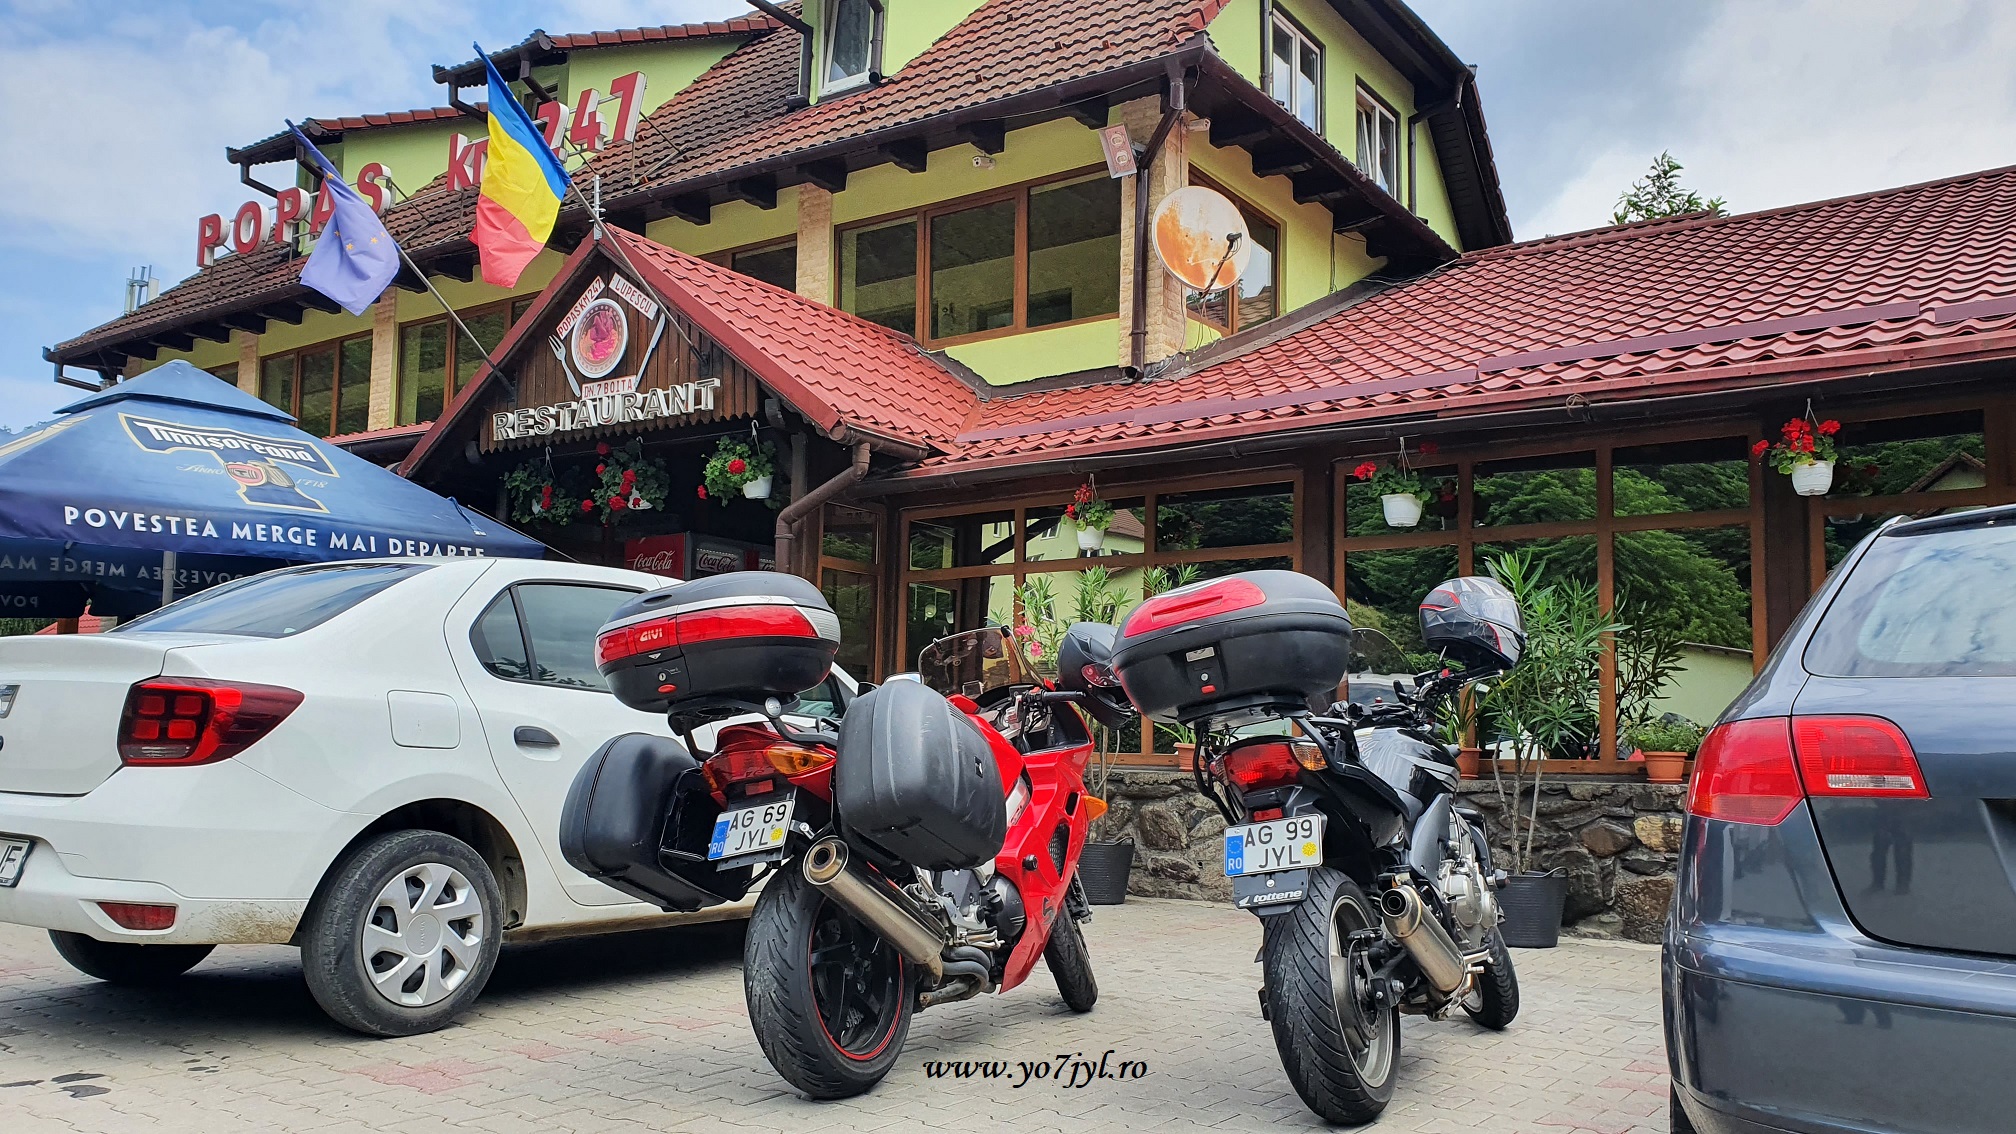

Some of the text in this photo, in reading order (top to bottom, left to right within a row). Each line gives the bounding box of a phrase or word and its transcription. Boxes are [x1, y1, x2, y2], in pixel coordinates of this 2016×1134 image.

[197, 162, 391, 268] POPAS
[537, 71, 646, 164] 247
[615, 278, 653, 314] LUPESCU
[492, 377, 721, 442] RESTAURANT
[64, 505, 485, 557] POVESTEA MERGE MAI DEPARTE
[639, 627, 663, 642] GIVI
[729, 803, 787, 832] AG 69
[711, 841, 724, 854] RO
[734, 828, 769, 851] JYL
[1244, 818, 1313, 848] AG 99
[1228, 857, 1243, 871] RO
[1258, 844, 1302, 869] JYL
